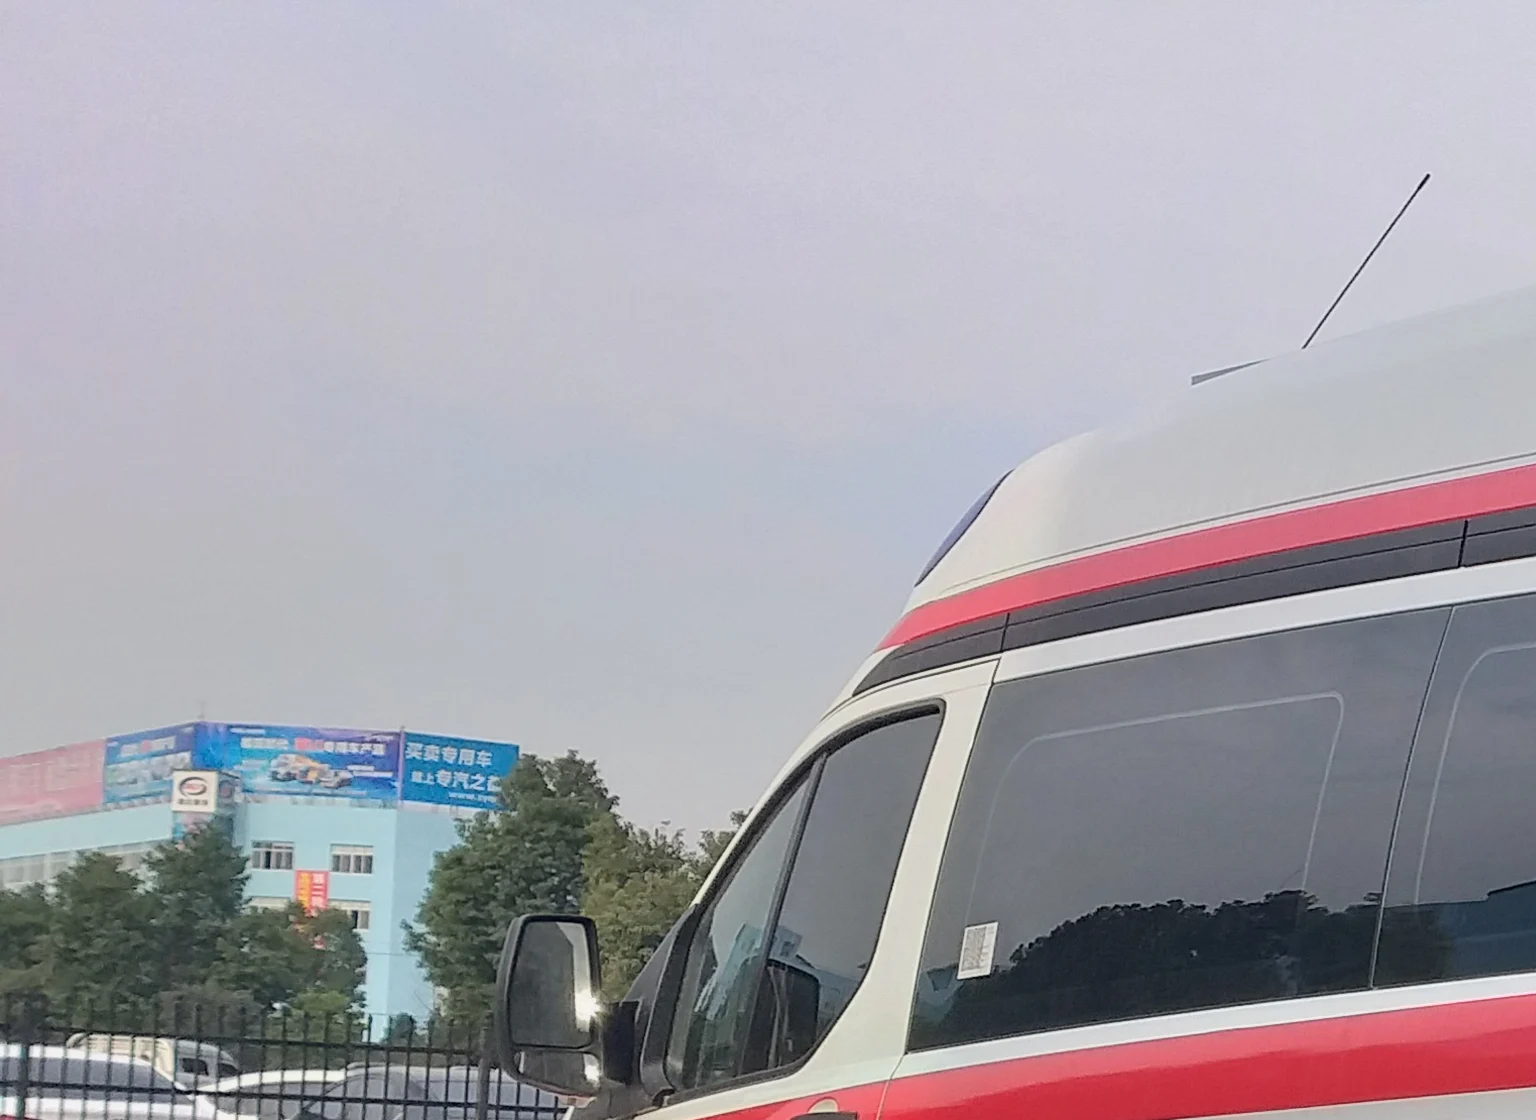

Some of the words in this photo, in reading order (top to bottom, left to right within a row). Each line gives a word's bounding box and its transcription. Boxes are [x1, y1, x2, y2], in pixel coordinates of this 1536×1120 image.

[405, 741, 492, 767] 买卖专用车
